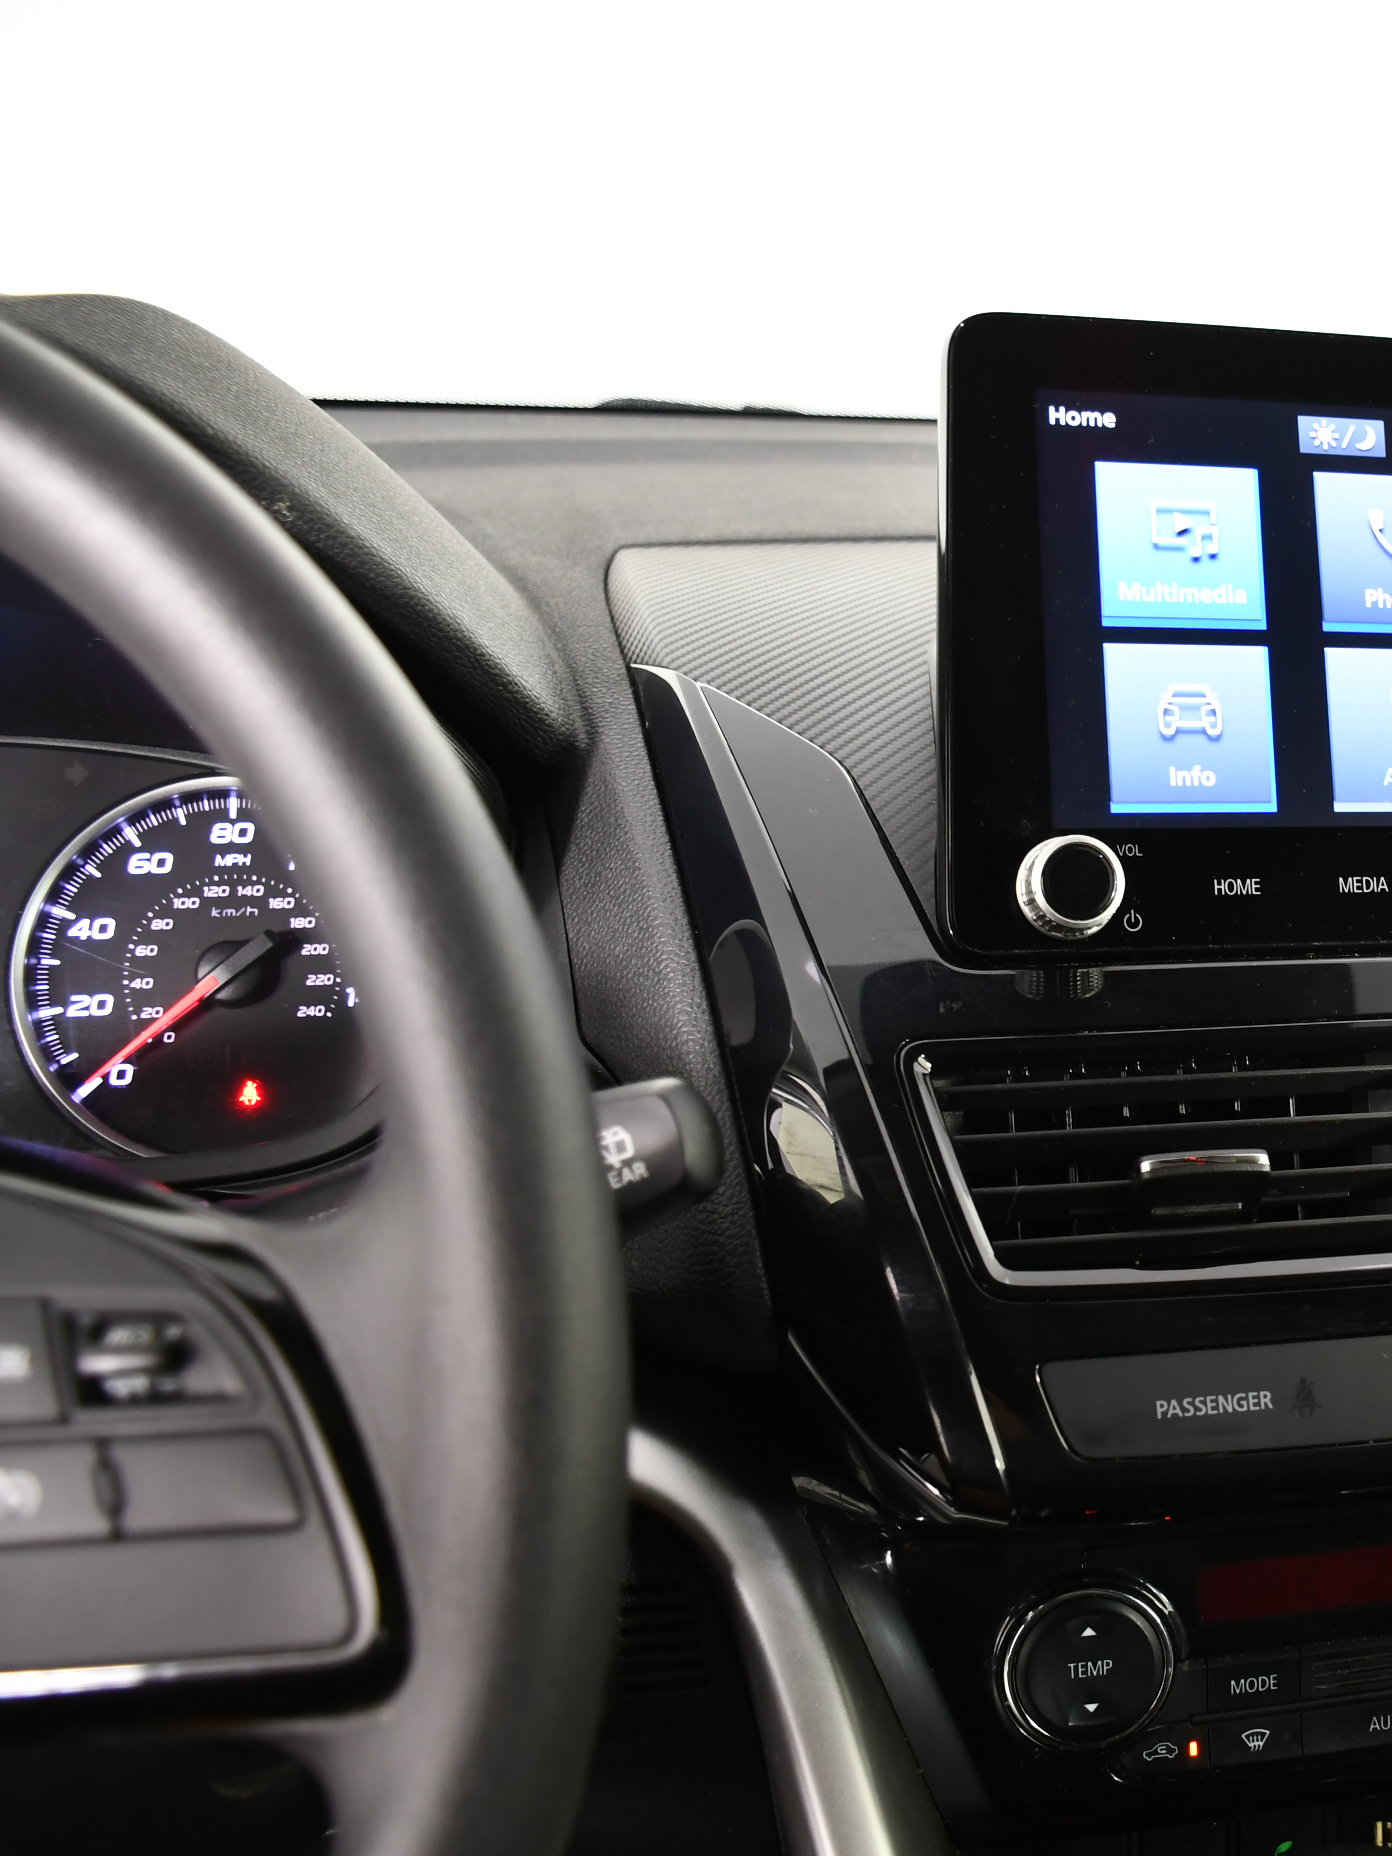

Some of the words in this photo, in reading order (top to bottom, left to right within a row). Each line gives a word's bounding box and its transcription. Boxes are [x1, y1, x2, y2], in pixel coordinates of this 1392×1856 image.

[1048, 405, 1117, 428] Home
[1118, 580, 1249, 605] Multimedia
[1169, 764, 1217, 788] Info
[209, 822, 256, 845] 80
[1116, 843, 1144, 857] VOL
[127, 852, 174, 875] 60
[214, 853, 252, 868] MPH
[203, 885, 230, 898] 120
[236, 884, 265, 897] 140
[1213, 878, 1262, 896] HOME
[1338, 876, 1389, 894] MEDIA
[172, 897, 200, 909] 100
[268, 897, 295, 910] 160
[210, 905, 259, 919] km/h
[66, 917, 116, 941] 40
[150, 919, 174, 931] 80
[289, 917, 316, 930] 180
[134, 945, 158, 957] 60
[301, 943, 329, 956] 200
[130, 978, 154, 991] 40
[306, 973, 335, 986] 220
[65, 993, 115, 1018] 20
[297, 1005, 325, 1018] 240
[140, 1007, 164, 1019] 20
[163, 1031, 176, 1044] 0
[108, 1063, 134, 1087] 0
[607, 1160, 650, 1190] EAR
[1156, 1390, 1274, 1419] PASSENGER
[1068, 1659, 1113, 1679] TEMP
[1230, 1674, 1279, 1695] MODE
